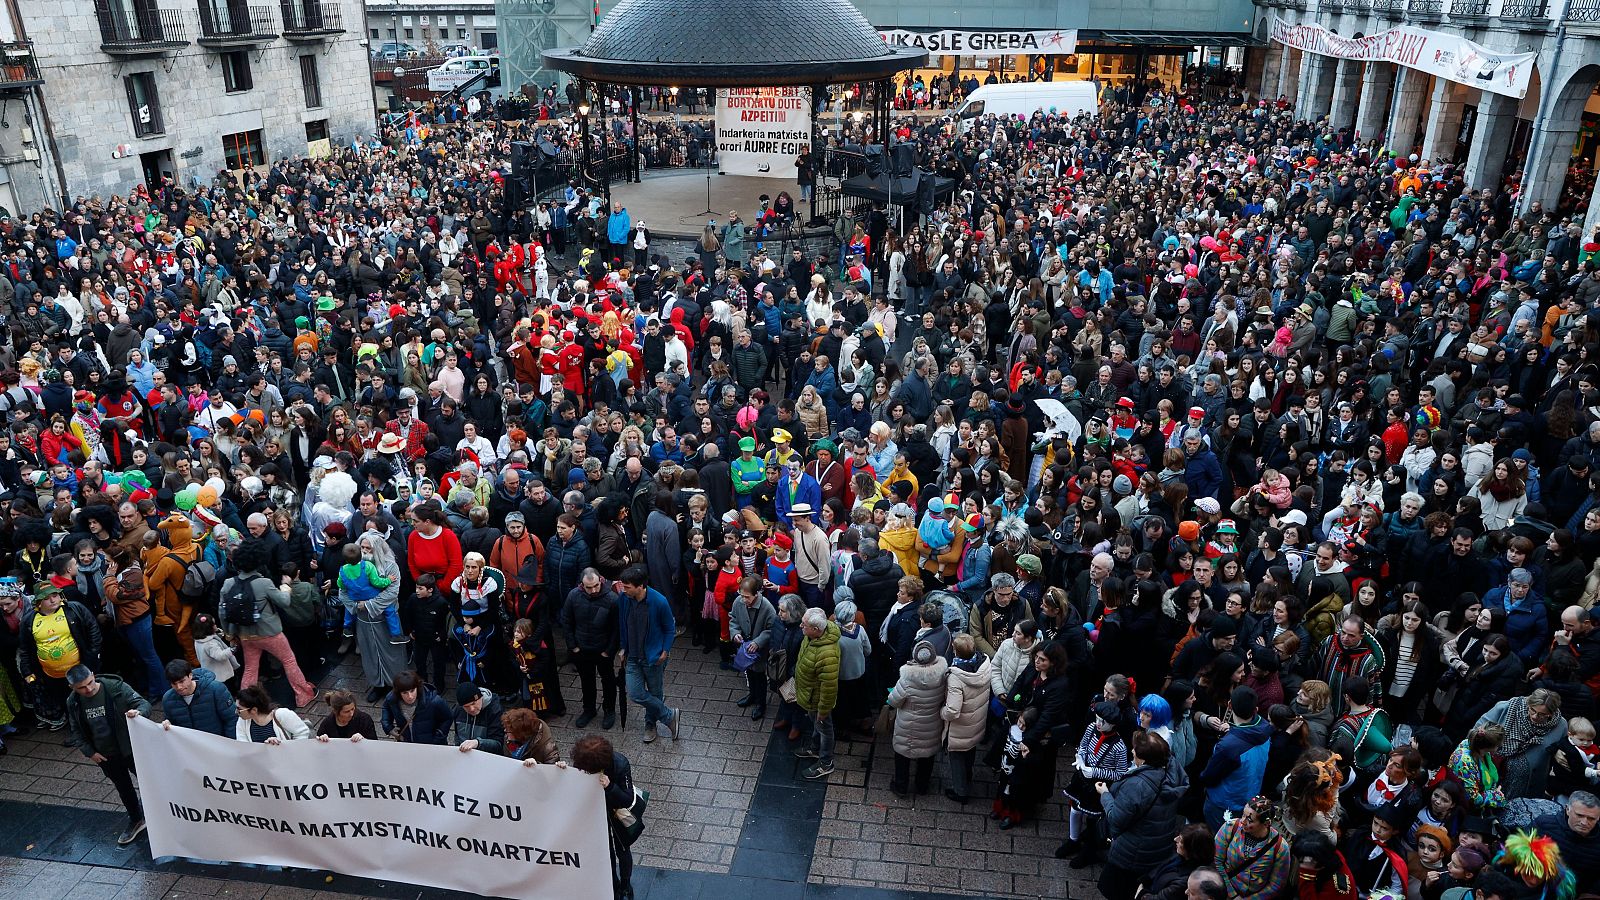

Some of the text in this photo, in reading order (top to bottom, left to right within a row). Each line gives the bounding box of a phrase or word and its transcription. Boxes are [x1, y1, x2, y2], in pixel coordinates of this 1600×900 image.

[891, 34, 962, 51] IKASLE
[968, 33, 1038, 50] GREBA
[1382, 30, 1427, 64] ERAIKI
[782, 86, 799, 96] BAT
[728, 97, 801, 109] BORTXATU DUTE
[740, 110, 786, 122] AZPEITIN
[720, 128, 808, 140] Indarkeria matxista
[720, 142, 742, 152] orori
[744, 140, 778, 154] AURRE
[203, 775, 522, 822] AZPEITIKO HERRIAK EZ DU
[169, 802, 580, 868] INDARKERIA MATXISTARIK ONARTZEN
